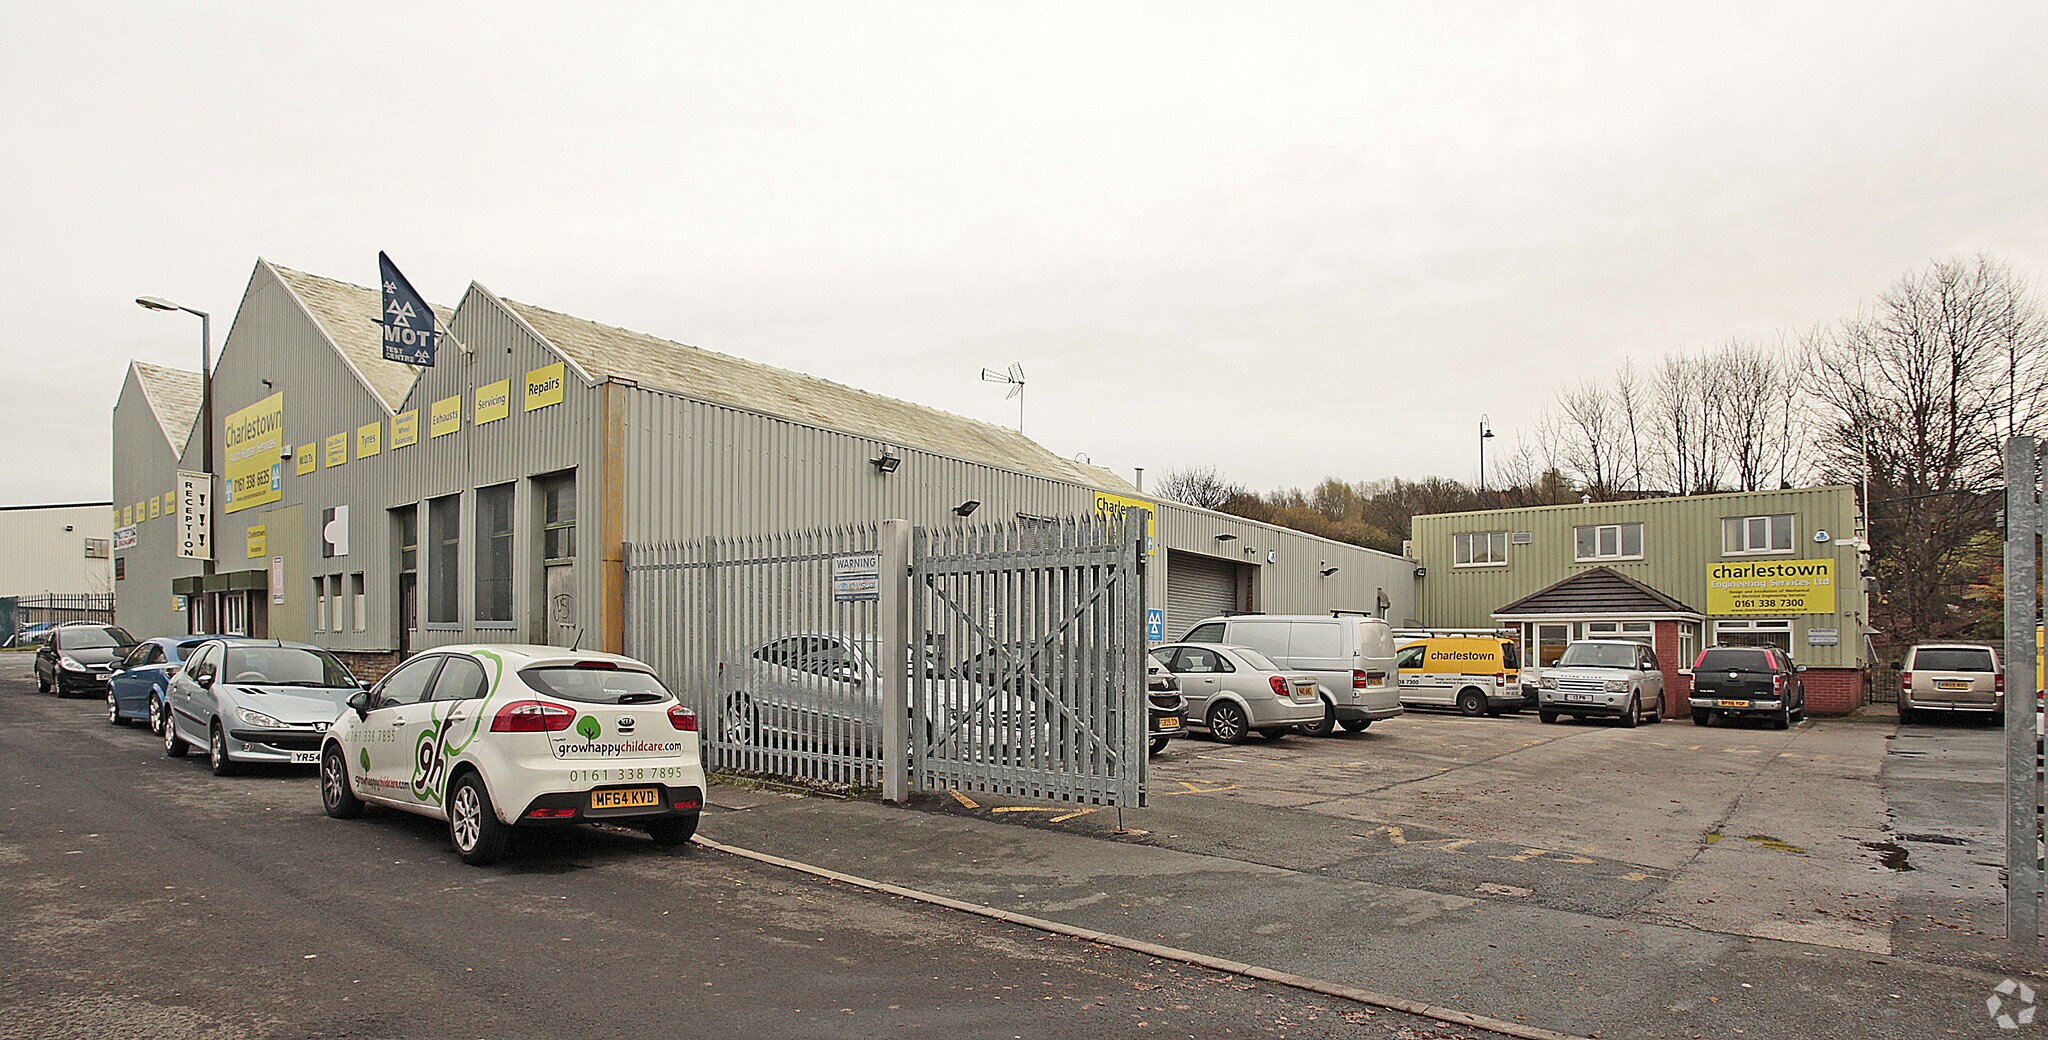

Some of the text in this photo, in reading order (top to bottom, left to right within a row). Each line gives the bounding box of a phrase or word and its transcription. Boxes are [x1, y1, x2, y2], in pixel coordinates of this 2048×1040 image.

[384, 324, 430, 347] MOT
[385, 345, 404, 354] TEST
[385, 352, 415, 363] CENTRE
[528, 376, 560, 397] Repairs
[478, 394, 506, 410] Servicing
[432, 410, 459, 426] Exhausts
[225, 409, 282, 449] Charlestown
[361, 434, 376, 448] Tyres
[233, 477, 245, 493] 0161
[245, 473, 256, 490] 338
[1096, 497, 1153, 521] Charlen
[184, 481, 194, 557] RECEPTION
[836, 557, 876, 569] WARNING
[1712, 563, 1828, 579] charlestown
[1711, 577, 1831, 589] Engineering Services Ltd
[1734, 599, 1804, 608] 0161 338 7300
[1431, 651, 1495, 661] charlestown
[621, 717, 632, 725] KIA
[344, 729, 396, 743] 0161 338 7895
[558, 740, 682, 758] growhappychildcare.com
[296, 753, 321, 762] YR54
[570, 767, 682, 783] 0161 338 7895
[354, 775, 411, 792] growhappychildcare.com
[596, 790, 655, 806] MF64 KVD
